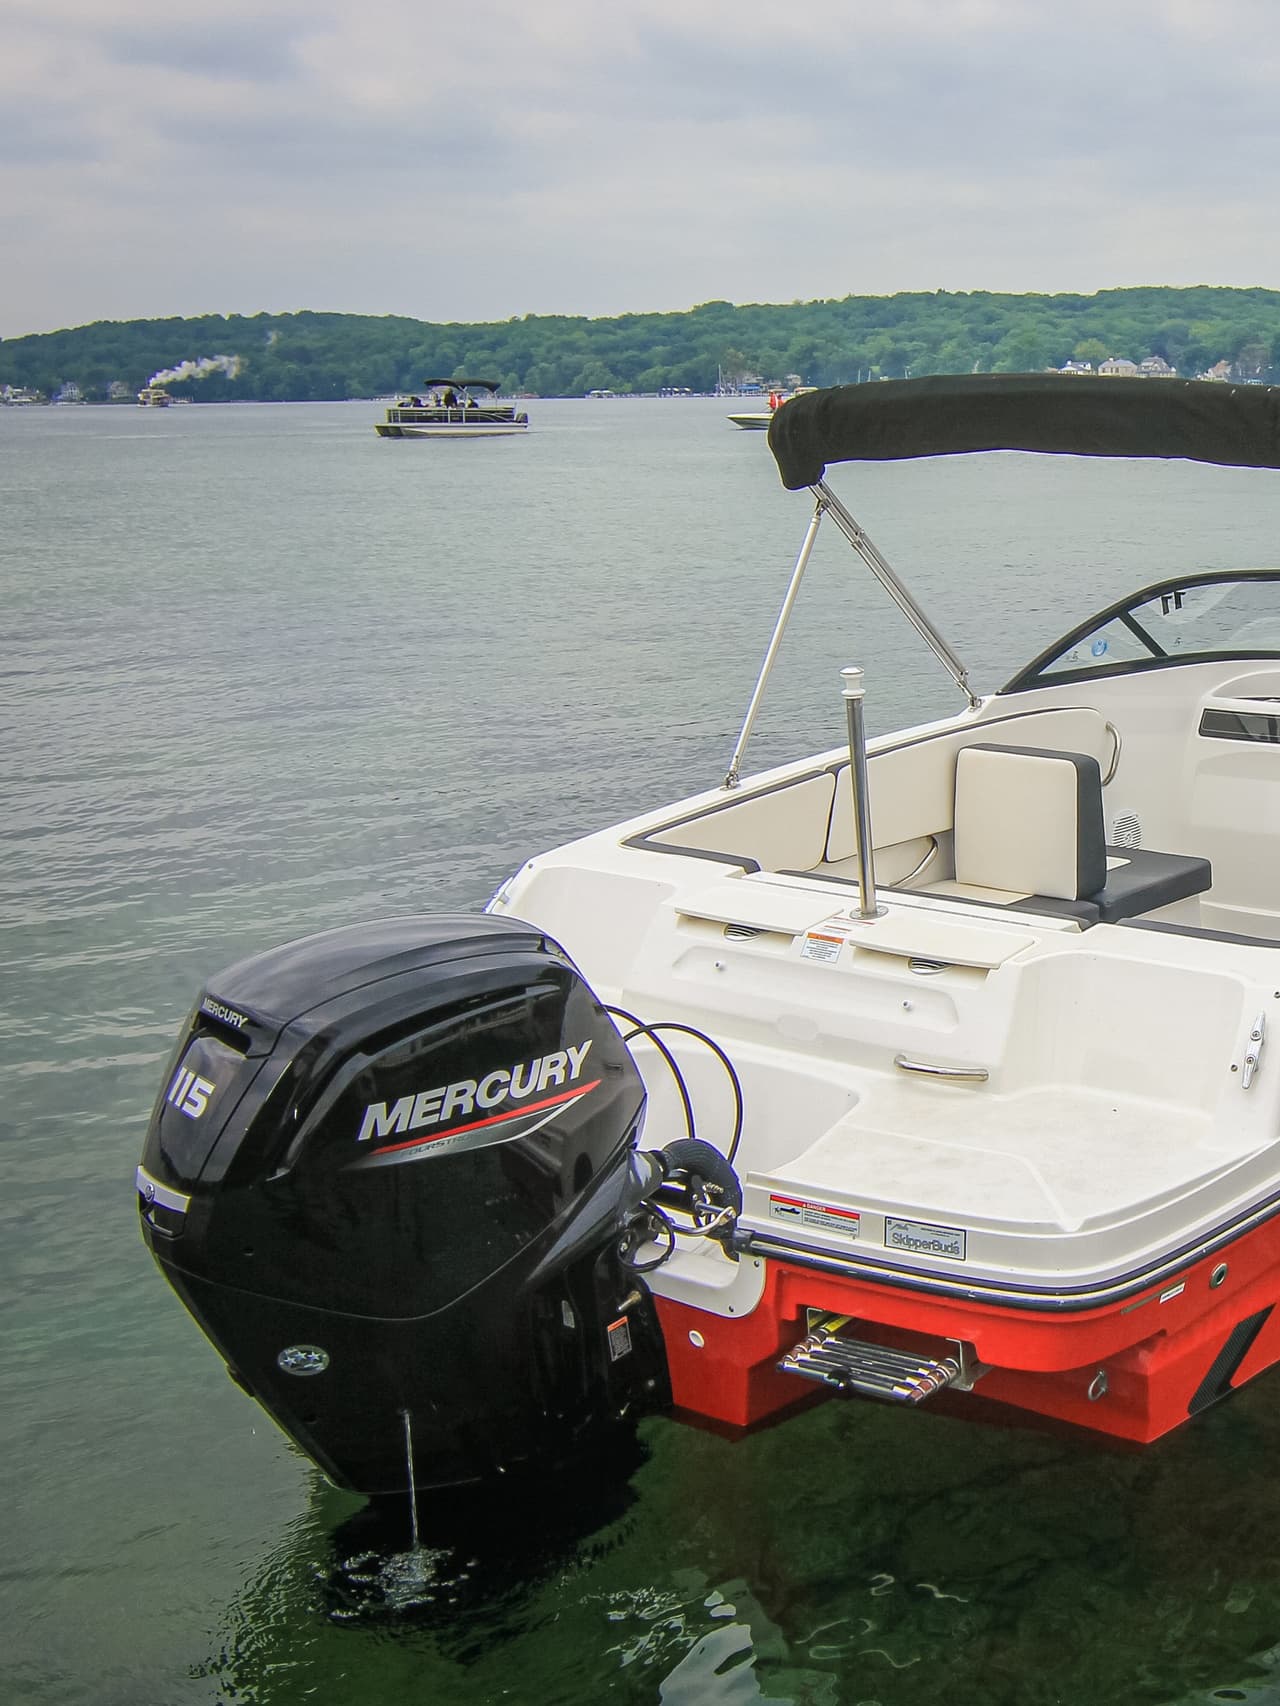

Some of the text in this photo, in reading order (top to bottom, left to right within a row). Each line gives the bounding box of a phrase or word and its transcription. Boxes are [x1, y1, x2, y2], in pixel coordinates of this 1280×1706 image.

[202, 997, 248, 1028] MERCURY
[167, 1066, 217, 1118] 115
[357, 1039, 593, 1141] MERCURY
